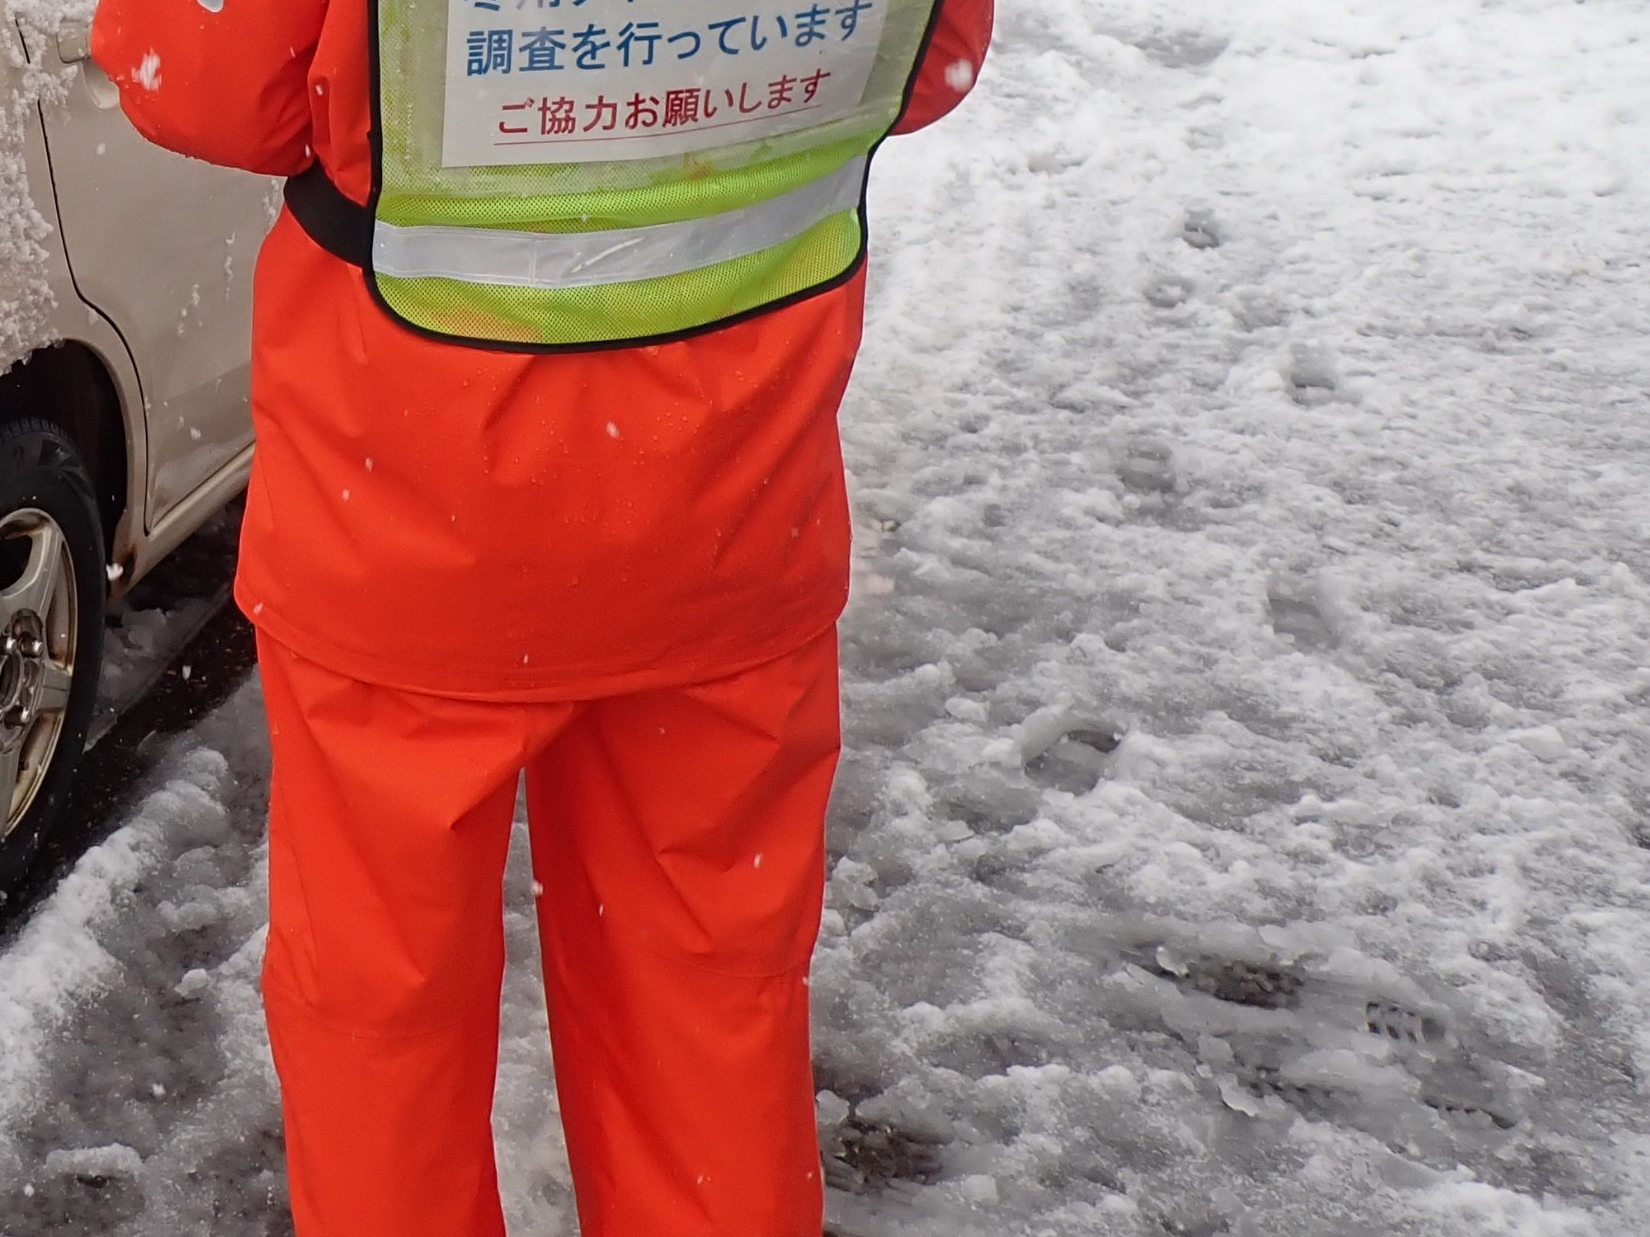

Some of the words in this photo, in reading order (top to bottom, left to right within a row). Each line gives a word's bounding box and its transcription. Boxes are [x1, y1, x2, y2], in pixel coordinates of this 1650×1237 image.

[497, 68, 832, 136] ご協力お願いします
